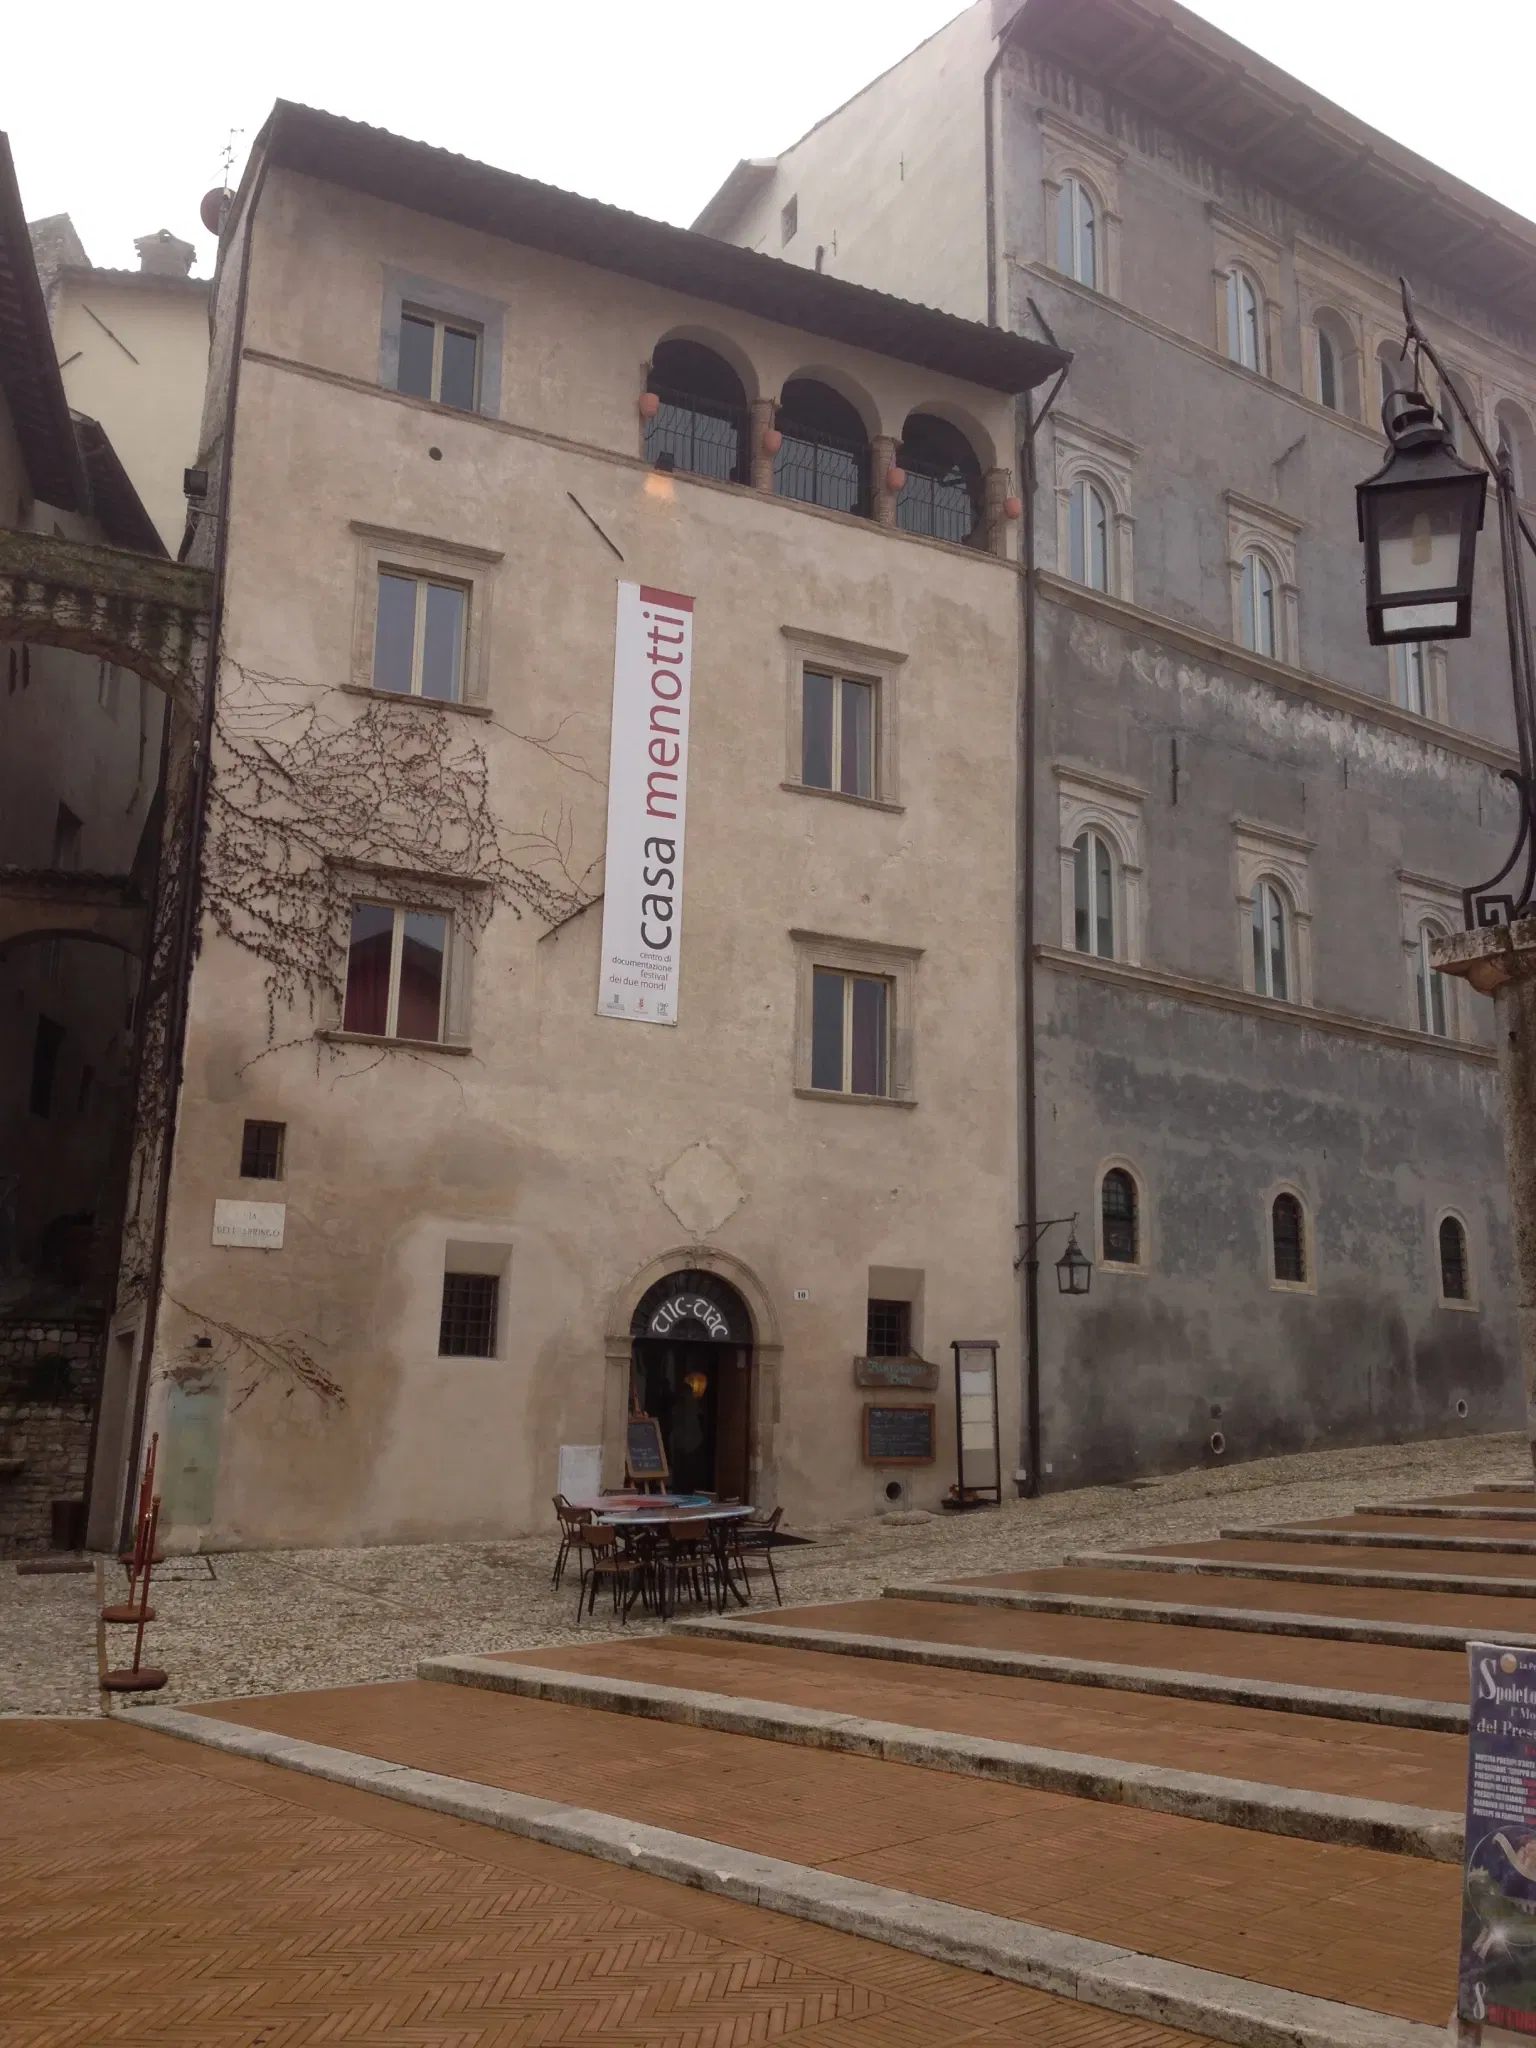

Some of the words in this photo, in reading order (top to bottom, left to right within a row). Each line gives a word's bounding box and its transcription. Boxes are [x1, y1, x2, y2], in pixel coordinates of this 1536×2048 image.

[642, 611, 685, 820] menotti
[641, 835, 676, 950] casa
[612, 956, 673, 973] documentazione
[640, 952, 663, 962] centro
[664, 955, 672, 963] di
[609, 974, 622, 984] dei
[623, 977, 639, 987] due
[640, 981, 667, 992] mondi
[640, 969, 668, 981] festival
[1476, 1718, 1497, 1735] del
